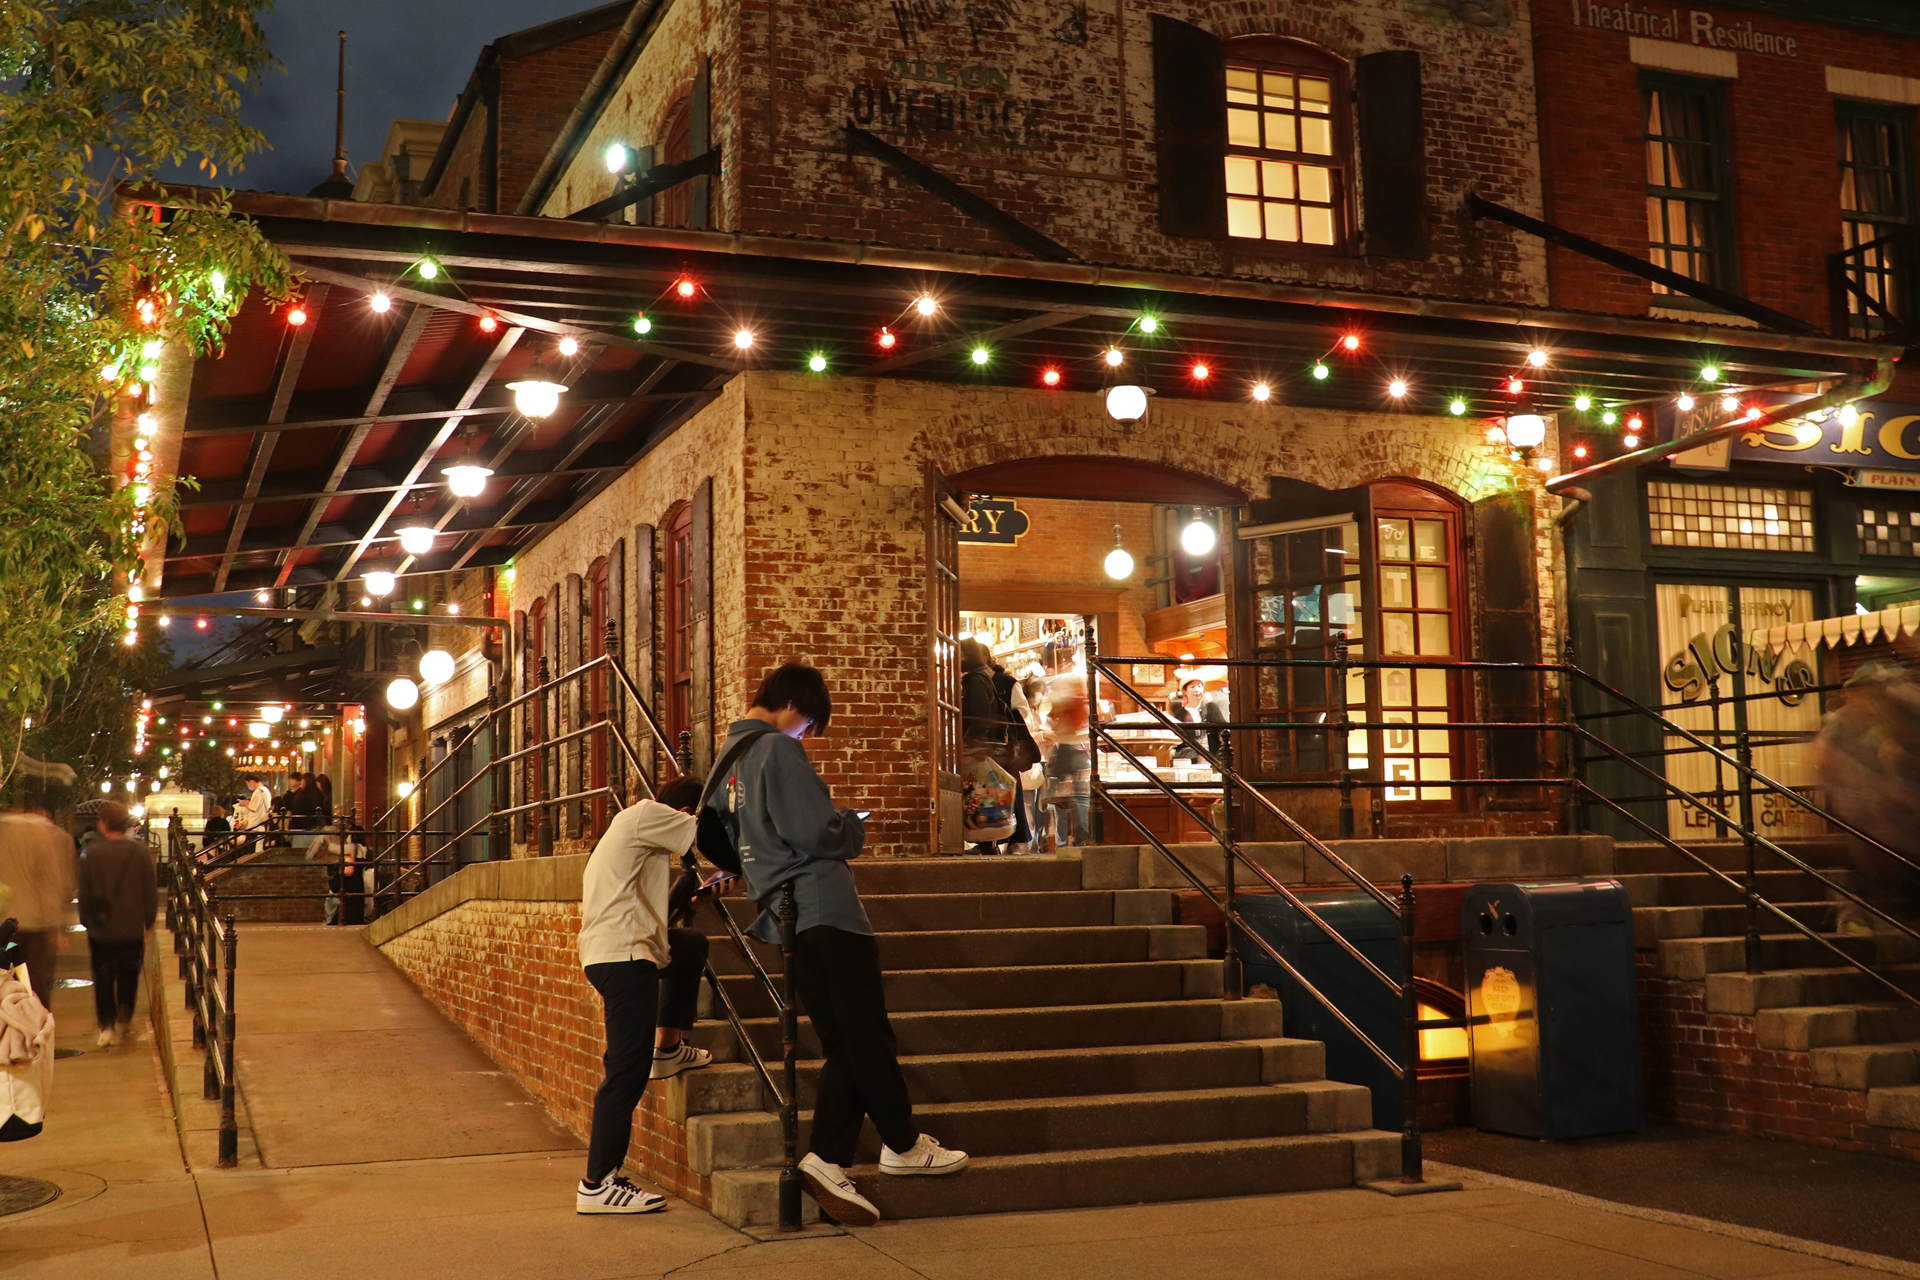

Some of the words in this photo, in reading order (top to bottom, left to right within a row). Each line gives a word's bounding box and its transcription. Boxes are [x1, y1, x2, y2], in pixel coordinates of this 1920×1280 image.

[1572, 0, 1679, 40] Theatrical
[1690, 10, 1798, 57] Residence
[961, 65, 1011, 90] ON
[853, 83, 922, 131] ONE
[1871, 474, 1916, 486] PLAIN
[1679, 593, 1724, 618] PLAIN
[1665, 623, 1816, 707] SIGNS
[1386, 571, 1413, 796] TRADE
[1493, 985, 1509, 993] KEEP
[1502, 995, 1516, 1003] CITY
